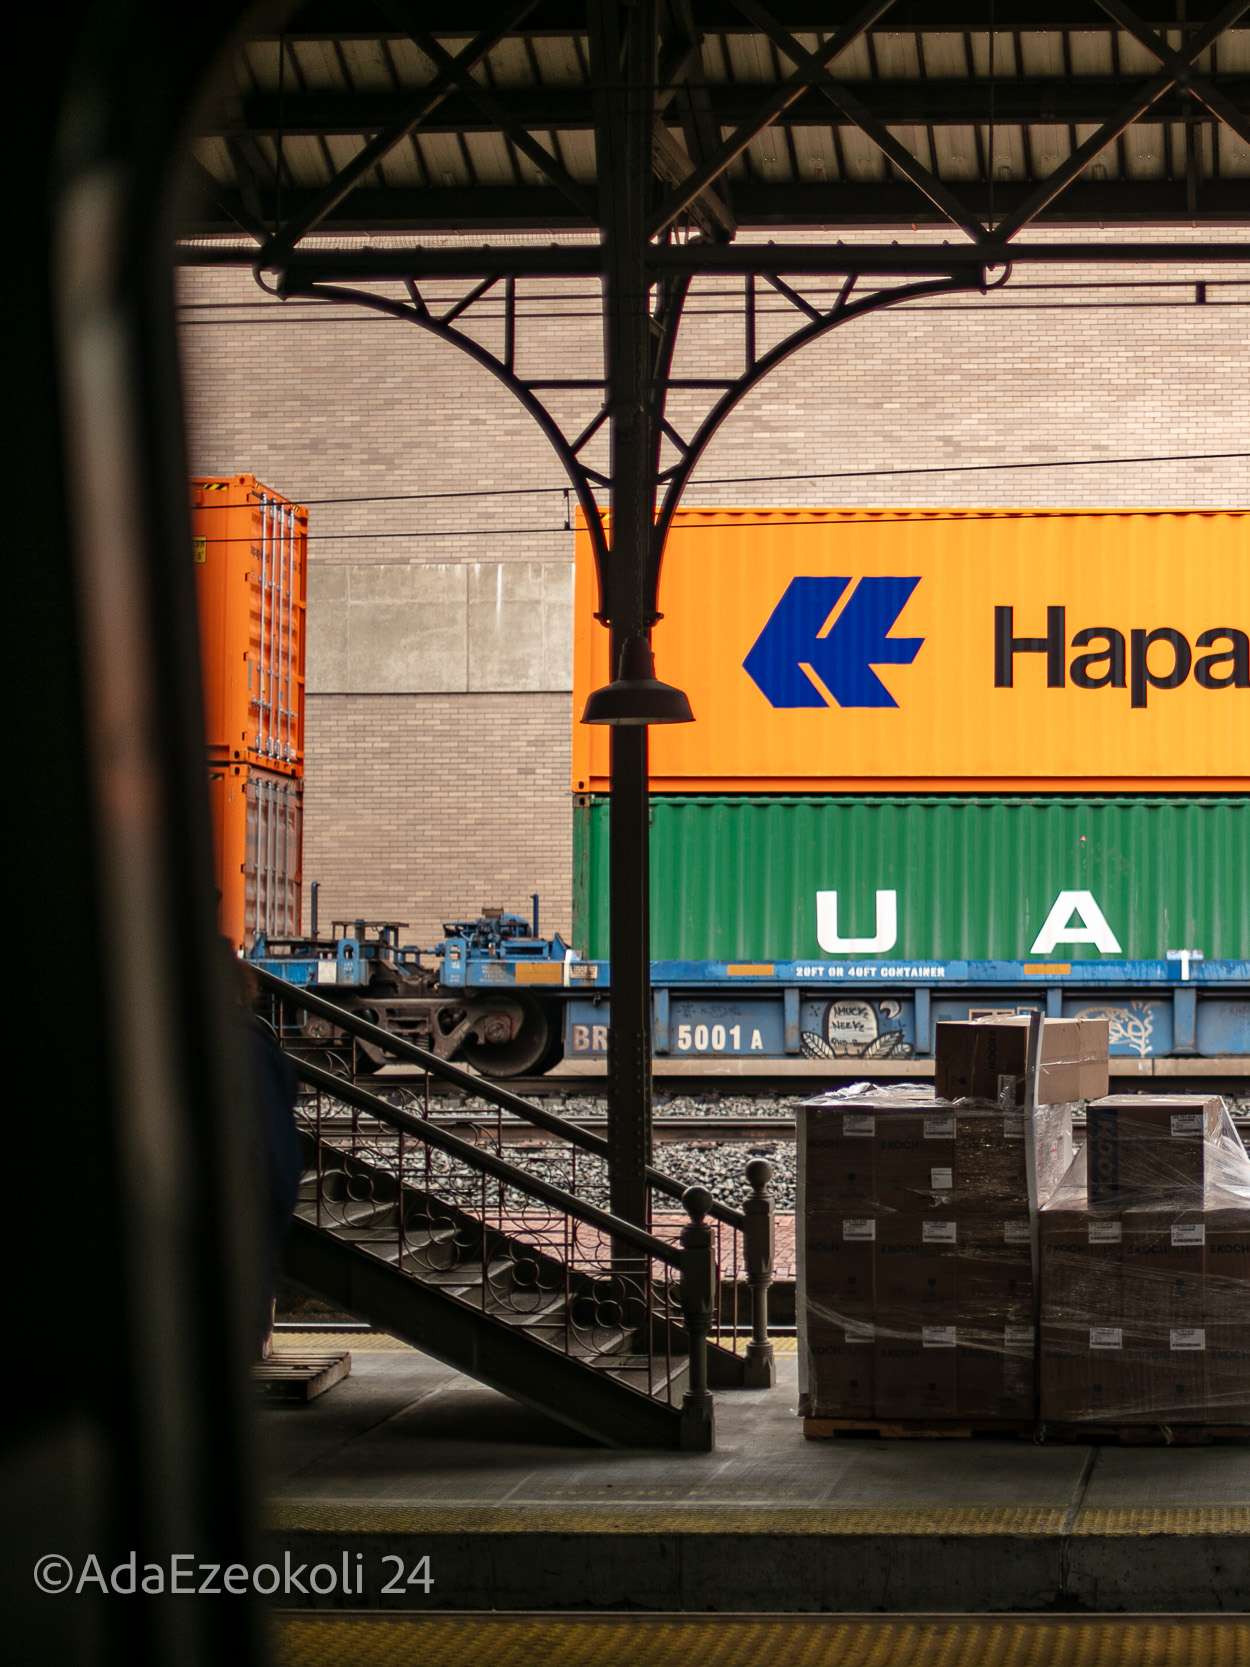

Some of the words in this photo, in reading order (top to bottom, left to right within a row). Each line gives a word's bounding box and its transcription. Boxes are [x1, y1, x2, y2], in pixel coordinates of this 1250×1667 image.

[795, 966, 825, 978] 20FT
[828, 966, 845, 978] OR
[847, 966, 878, 978] 40FT
[880, 966, 946, 978] CONTAINER
[677, 1024, 741, 1051] 5001
[750, 1030, 764, 1050] A
